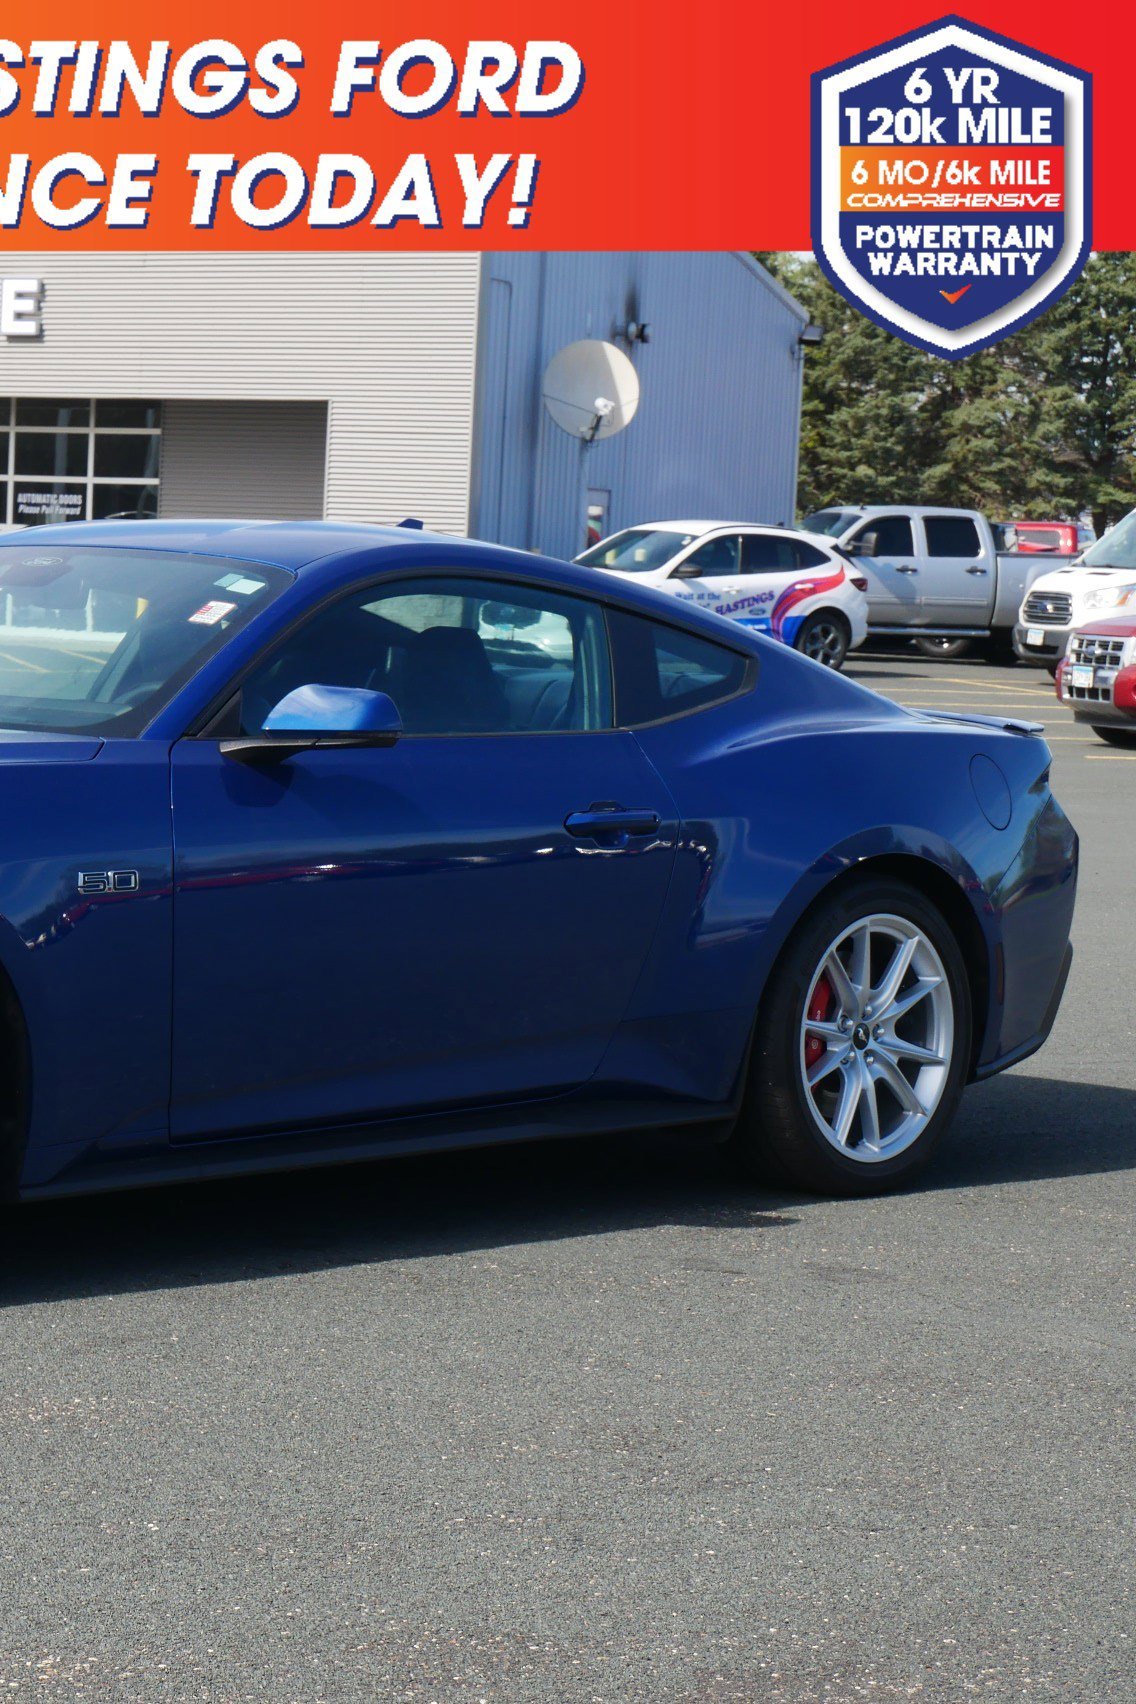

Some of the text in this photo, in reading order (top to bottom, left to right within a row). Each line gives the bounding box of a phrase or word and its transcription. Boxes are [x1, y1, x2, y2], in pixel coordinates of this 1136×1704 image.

[17, 493, 82, 505] AUTOMATIC DOORS
[715, 590, 775, 615] HASTINGS
